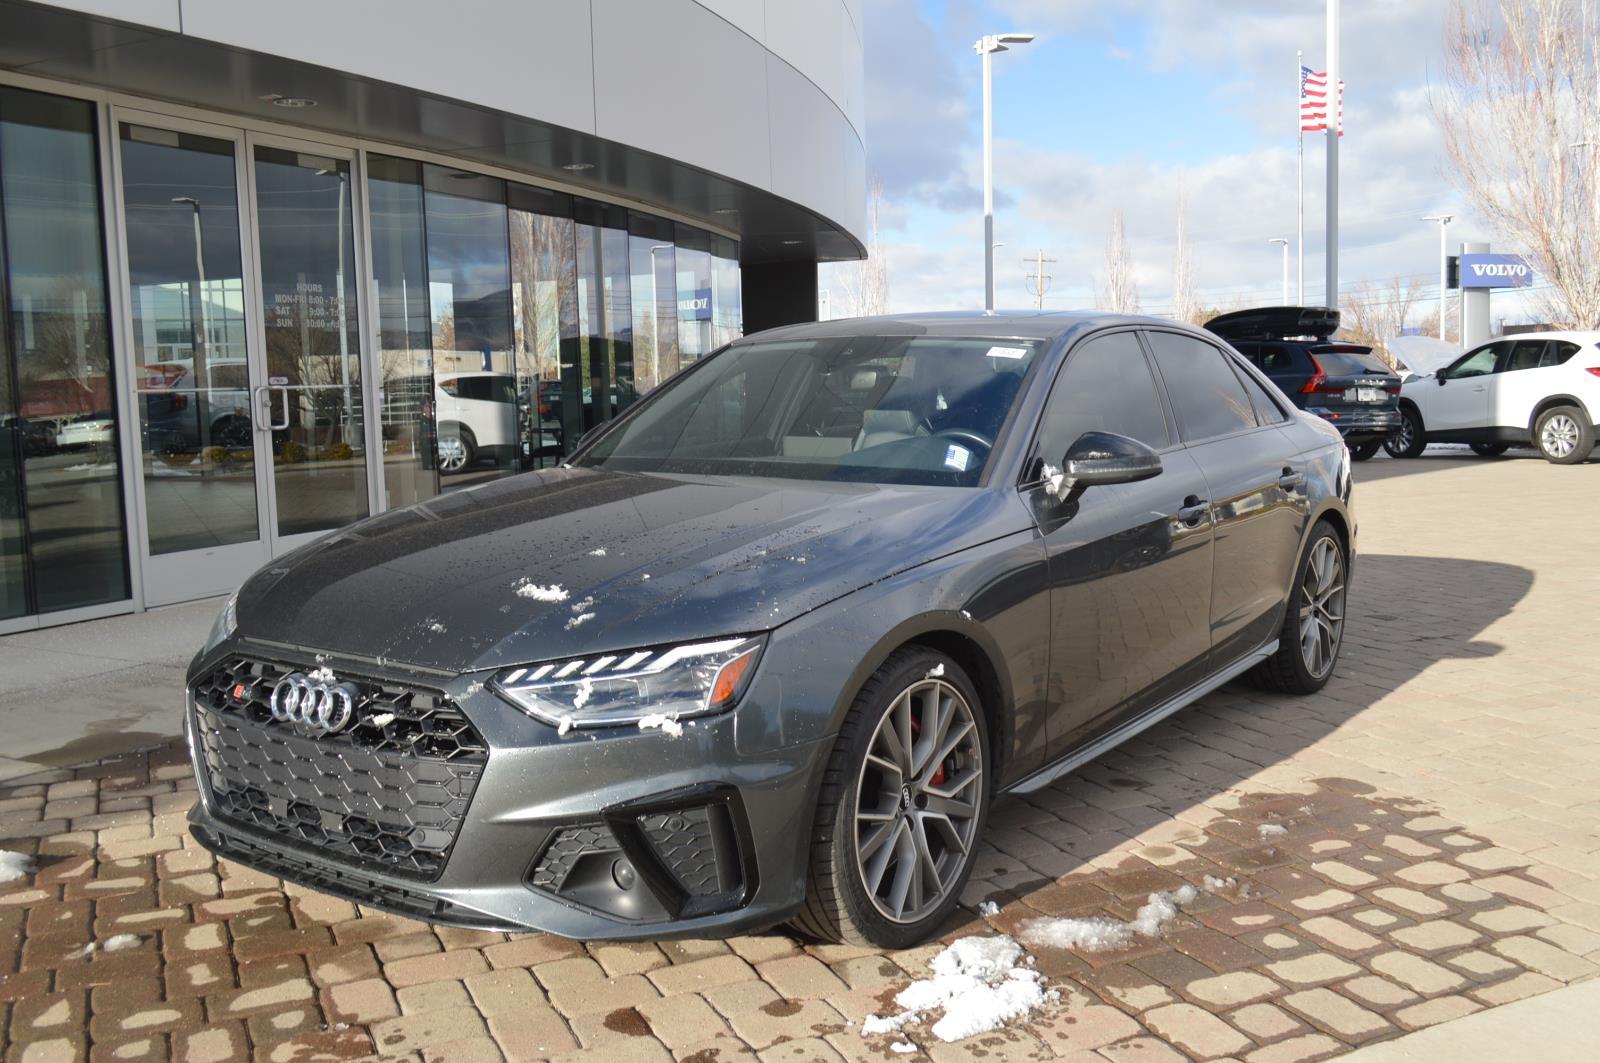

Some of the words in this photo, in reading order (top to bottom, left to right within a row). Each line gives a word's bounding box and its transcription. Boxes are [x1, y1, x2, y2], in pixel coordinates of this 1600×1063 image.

[1471, 264, 1526, 276] VOLVO
[296, 282, 323, 293] HOURS
[275, 305, 291, 315] SAT
[276, 318, 293, 328] SUN
